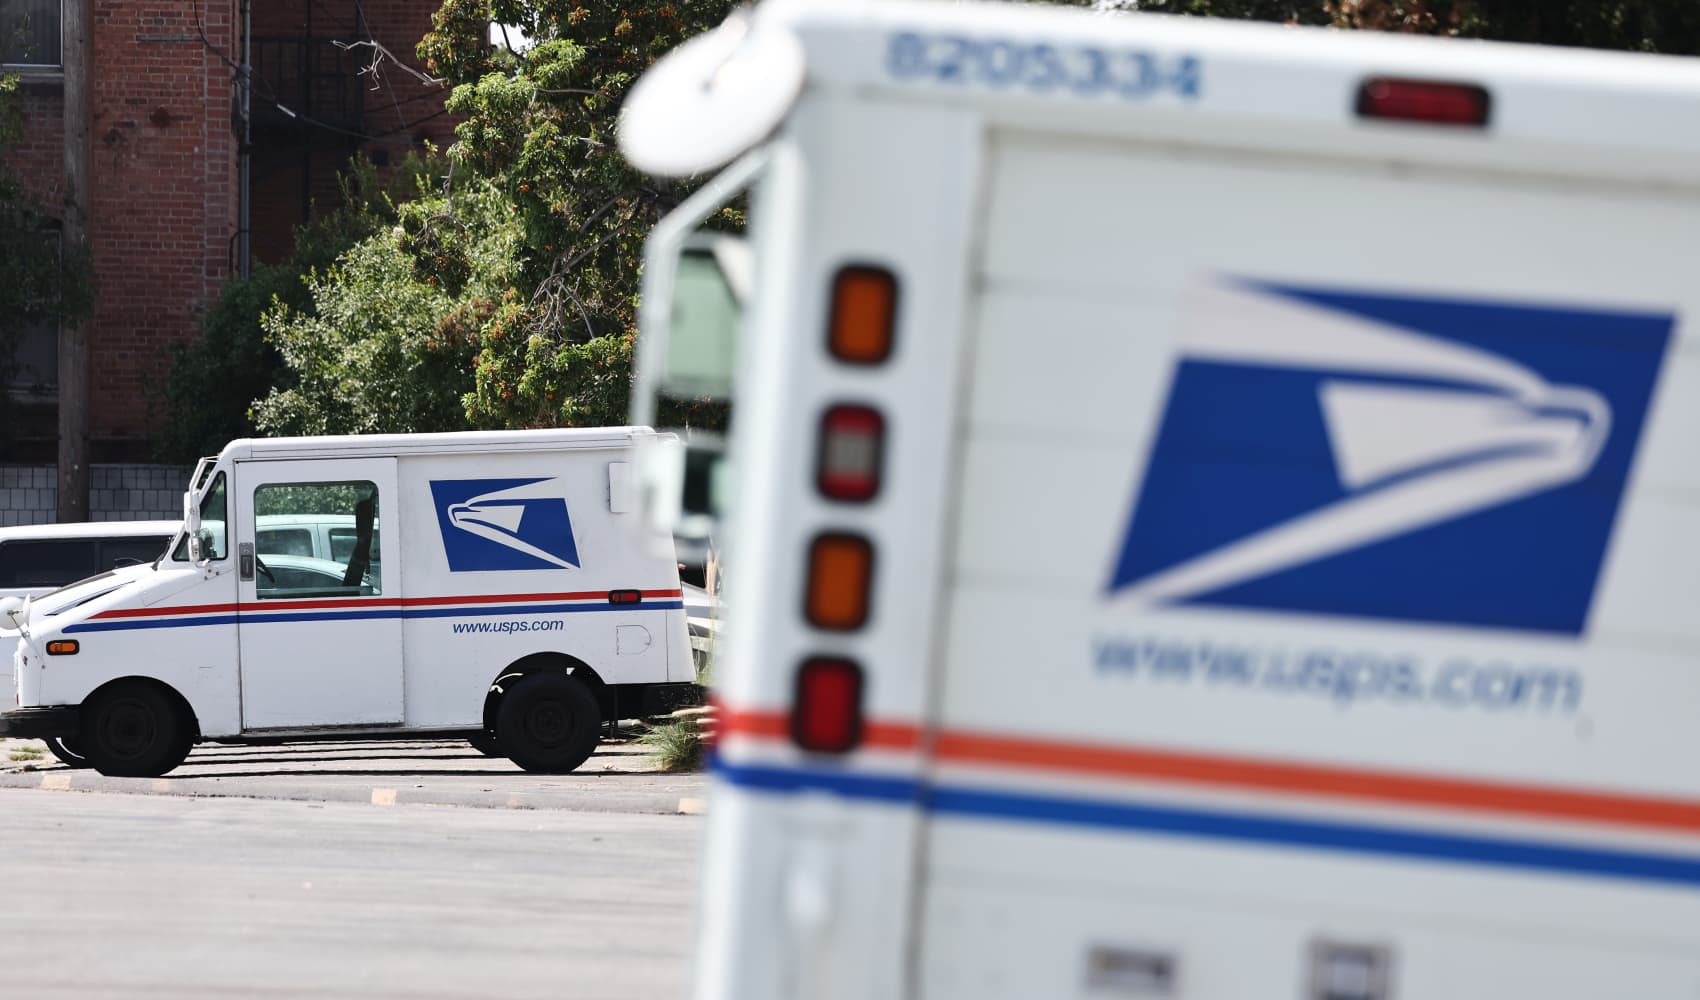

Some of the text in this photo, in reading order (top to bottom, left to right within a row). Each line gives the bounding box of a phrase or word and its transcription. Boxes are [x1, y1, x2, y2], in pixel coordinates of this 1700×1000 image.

[887, 31, 1203, 99] 8205334
[452, 619, 564, 634] www.usps.com
[1091, 634, 1583, 713] www.usps.com
